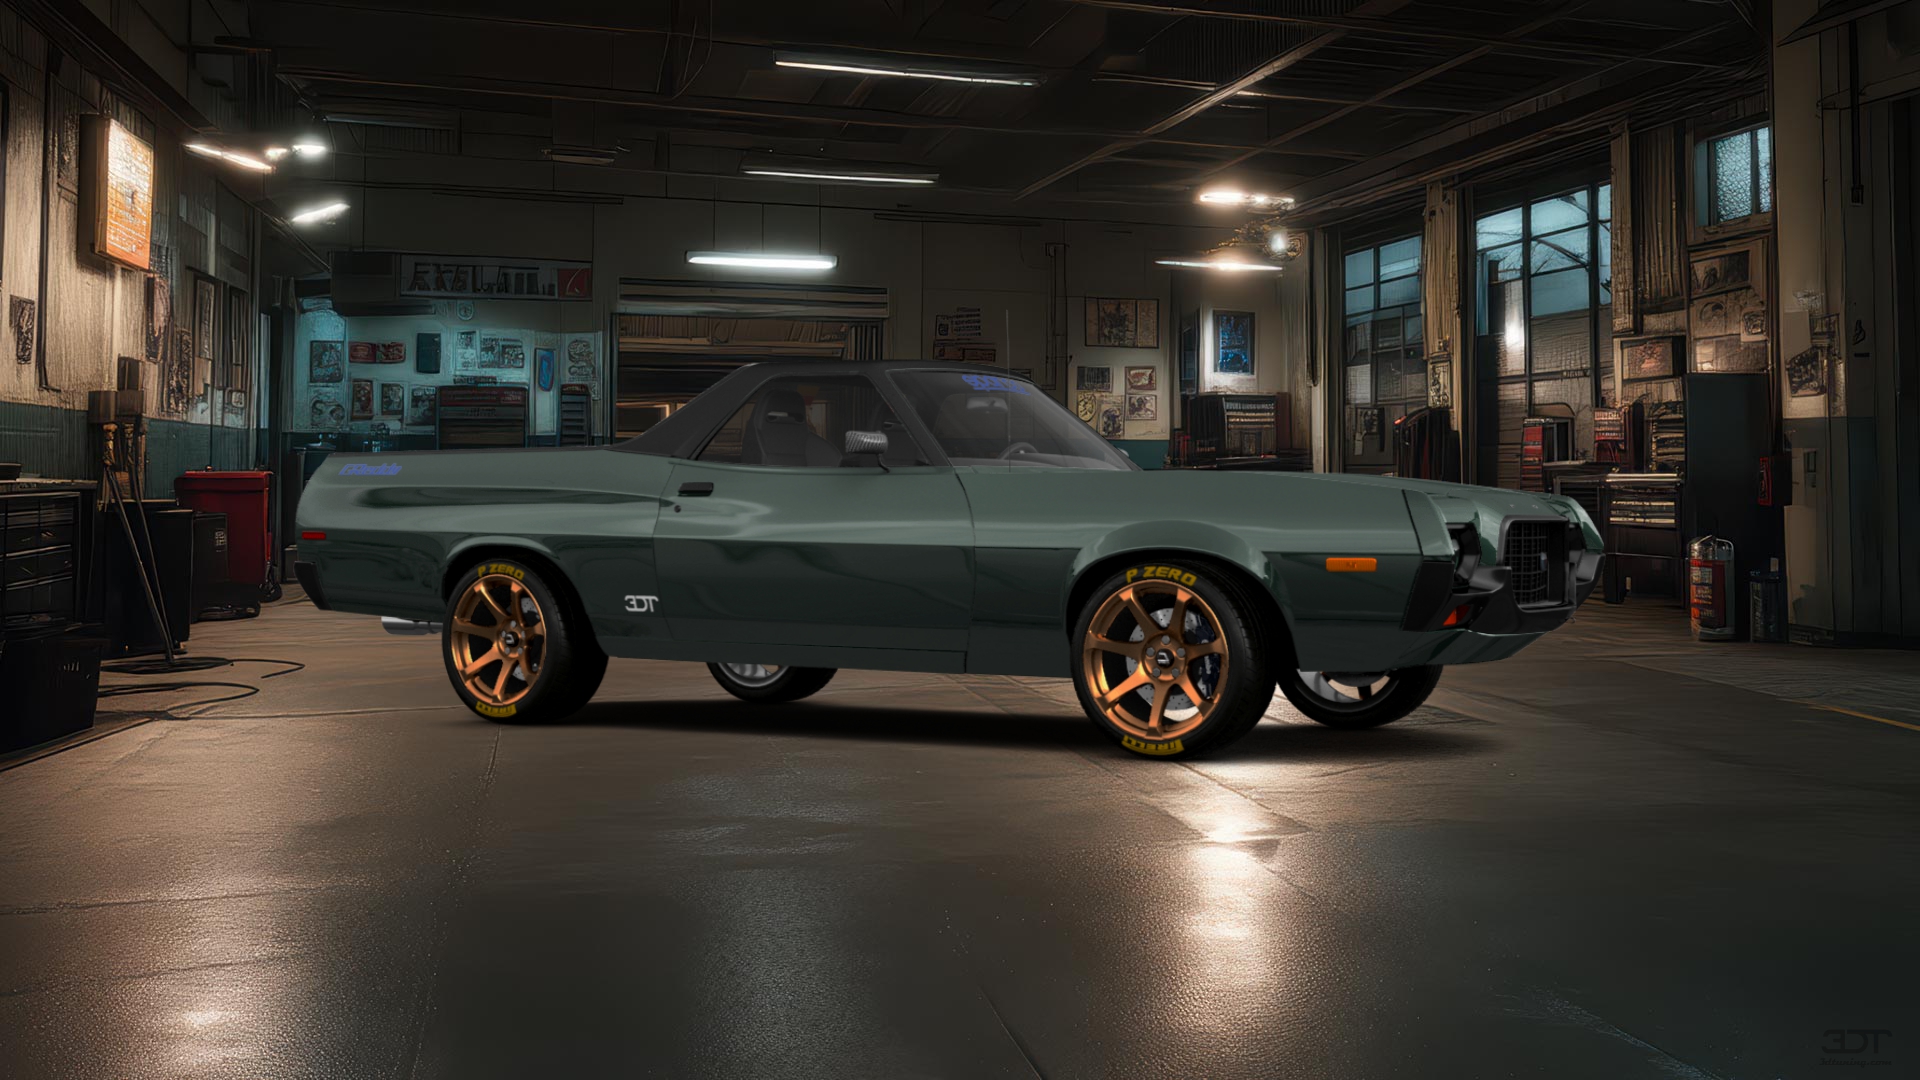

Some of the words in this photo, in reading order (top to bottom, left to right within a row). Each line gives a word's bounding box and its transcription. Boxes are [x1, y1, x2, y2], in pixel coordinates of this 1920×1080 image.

[477, 565, 487, 578] P
[488, 563, 525, 581] ZERO
[1125, 568, 1138, 584] P
[1142, 565, 1198, 587] ZERO
[624, 594, 659, 613] 3DT
